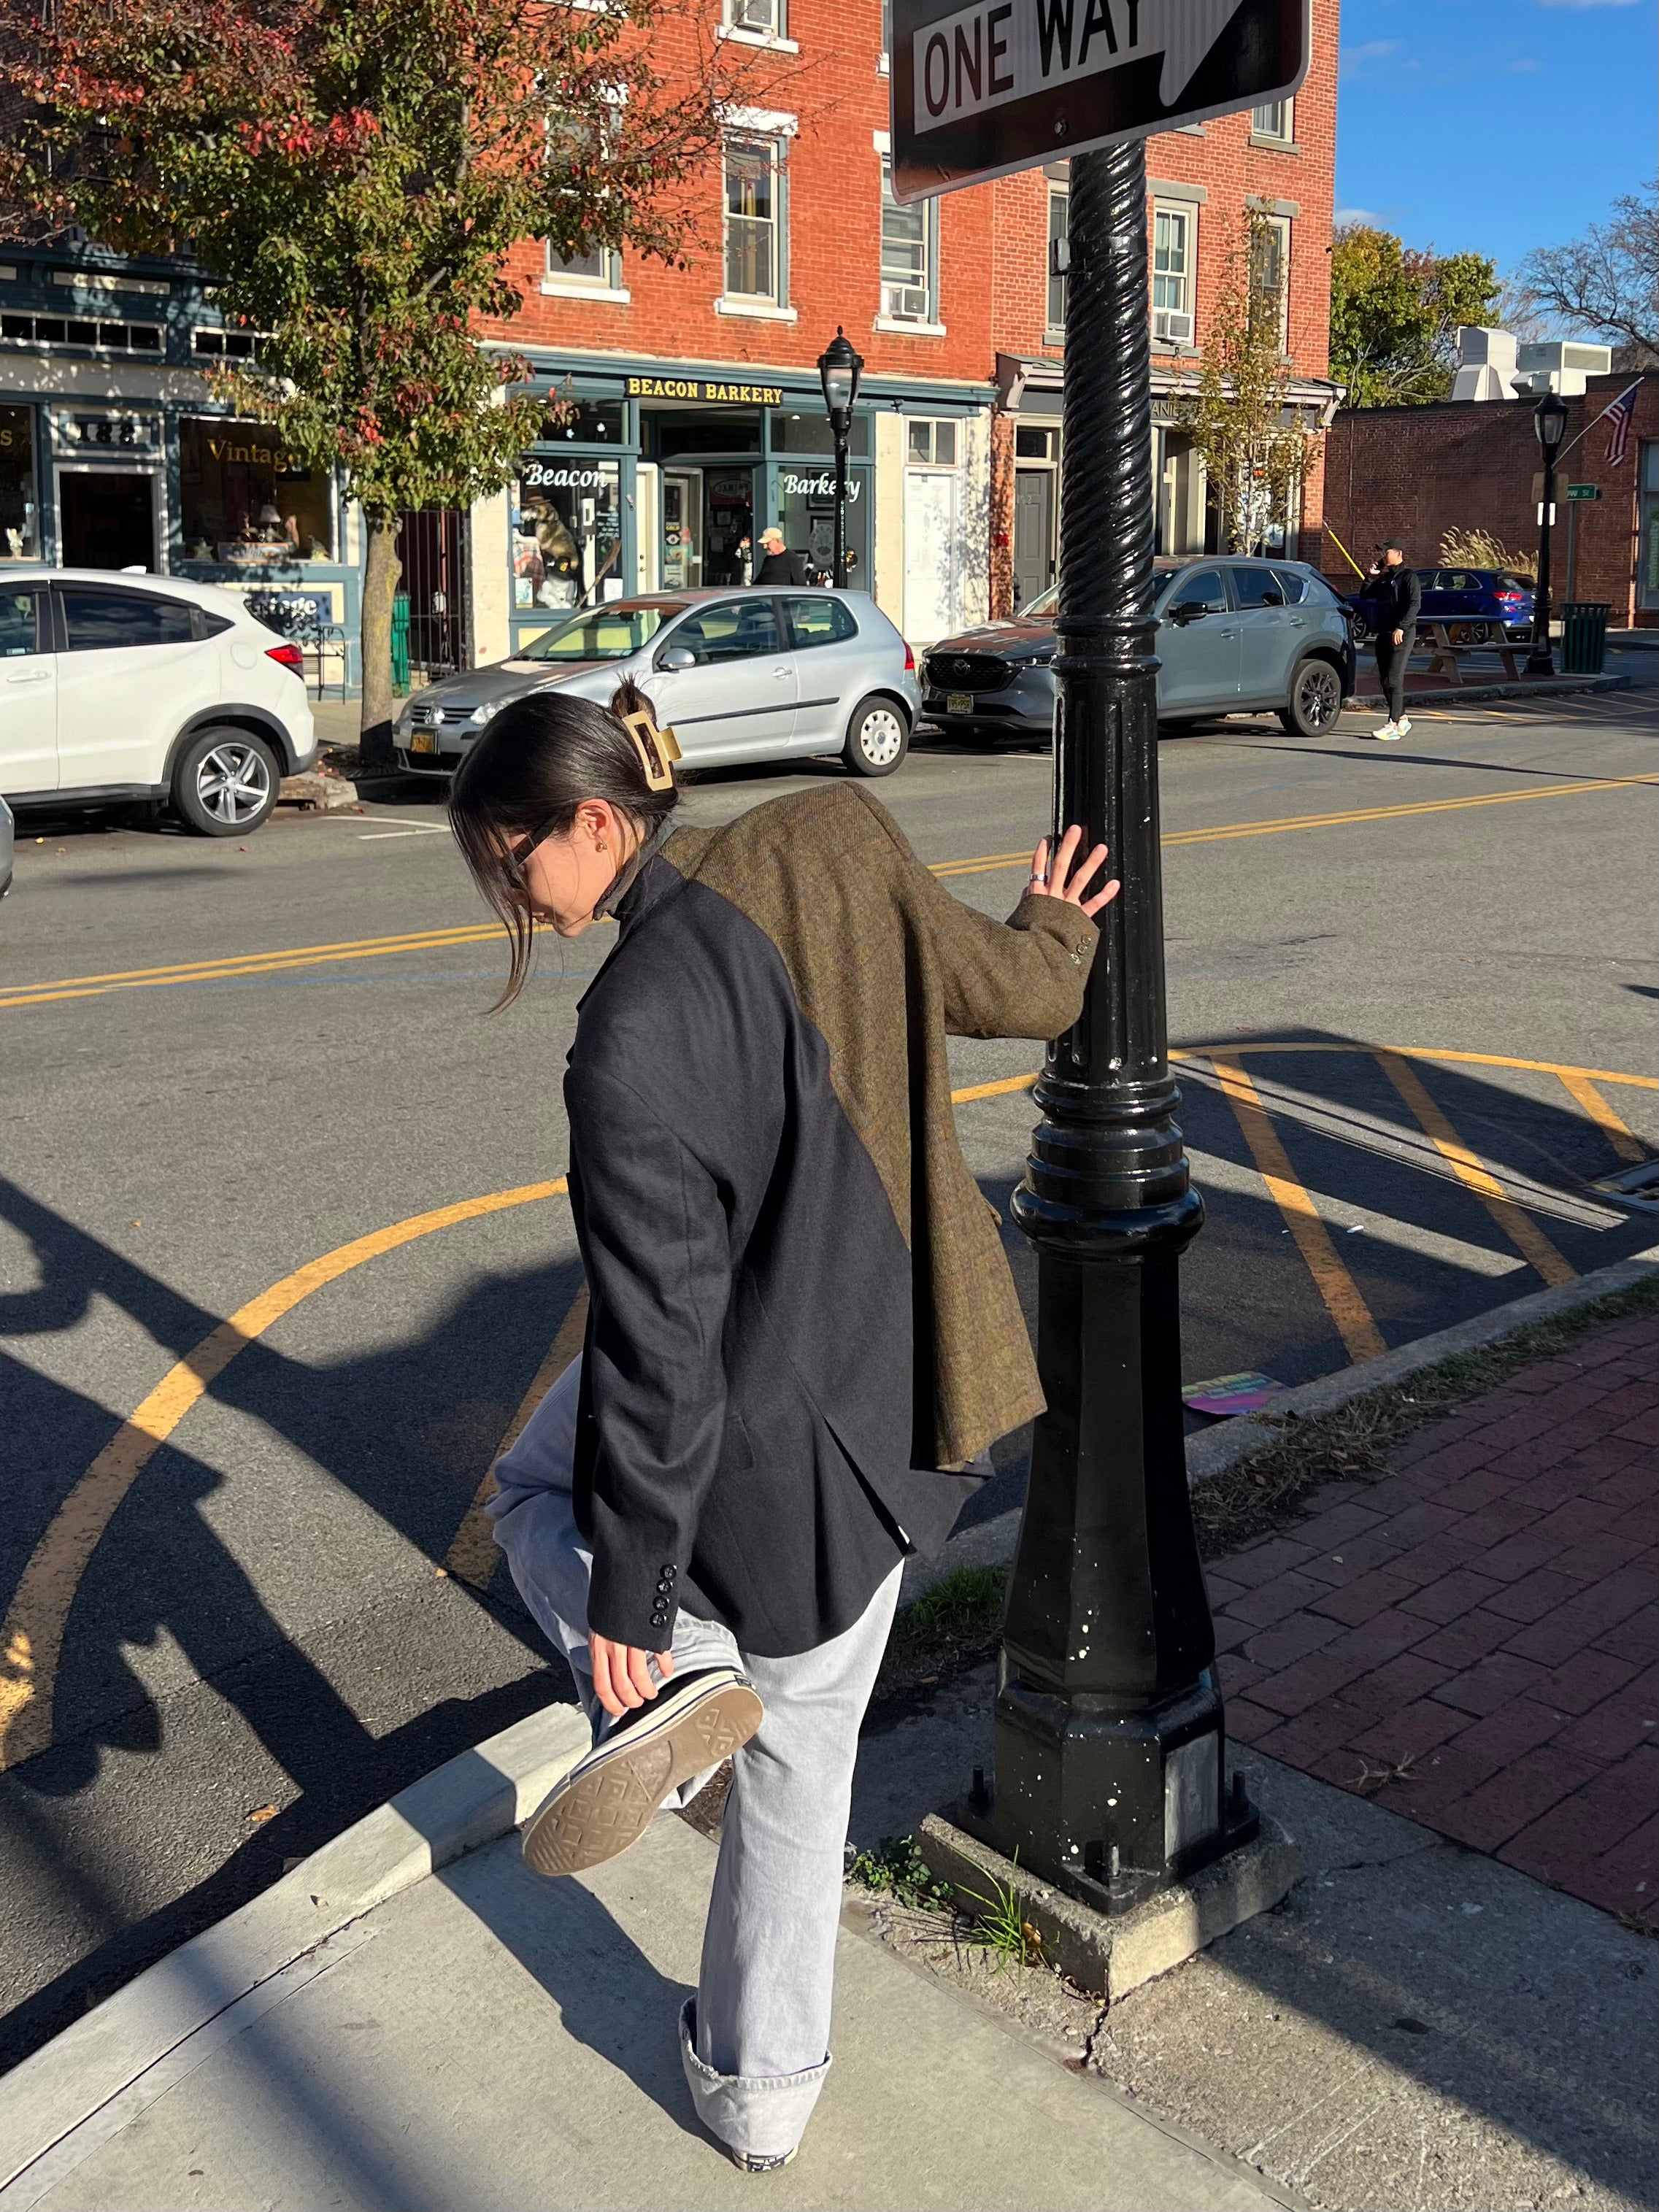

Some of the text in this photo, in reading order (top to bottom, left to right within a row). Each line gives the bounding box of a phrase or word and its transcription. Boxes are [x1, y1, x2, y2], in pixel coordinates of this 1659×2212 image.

[925, 0, 1138, 117] ONE WAY
[628, 377, 783, 404] BEACON BARKERY
[526, 462, 608, 488] Beacon
[784, 472, 861, 503] Barkey
